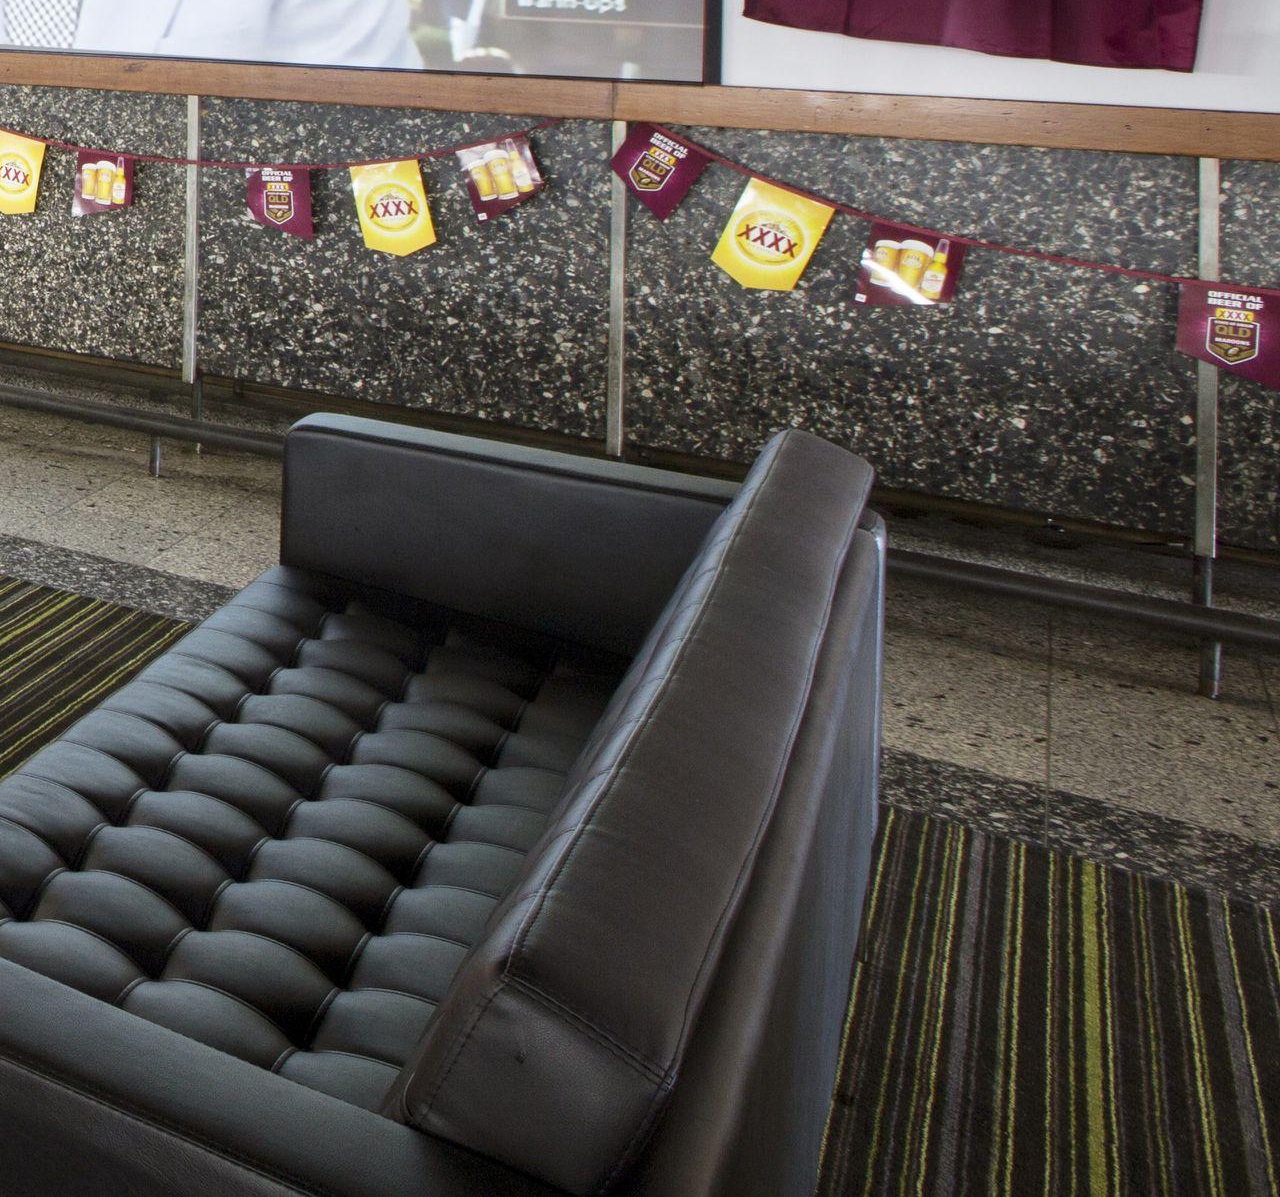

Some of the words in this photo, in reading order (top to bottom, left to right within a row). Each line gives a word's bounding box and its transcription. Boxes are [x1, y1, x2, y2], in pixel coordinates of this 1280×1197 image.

[650, 137, 673, 153] BEER
[673, 150, 687, 159] OF
[653, 132, 688, 154] OFFICIAL
[642, 159, 666, 176] QLD
[268, 195, 288, 203] QLD
[369, 201, 418, 219] XXXX
[737, 224, 797, 258] XXXX
[1208, 291, 1264, 303] OFFICIAL
[1208, 297, 1242, 308] BEER
[1246, 302, 1264, 310] OF
[1215, 325, 1252, 338] QLD
